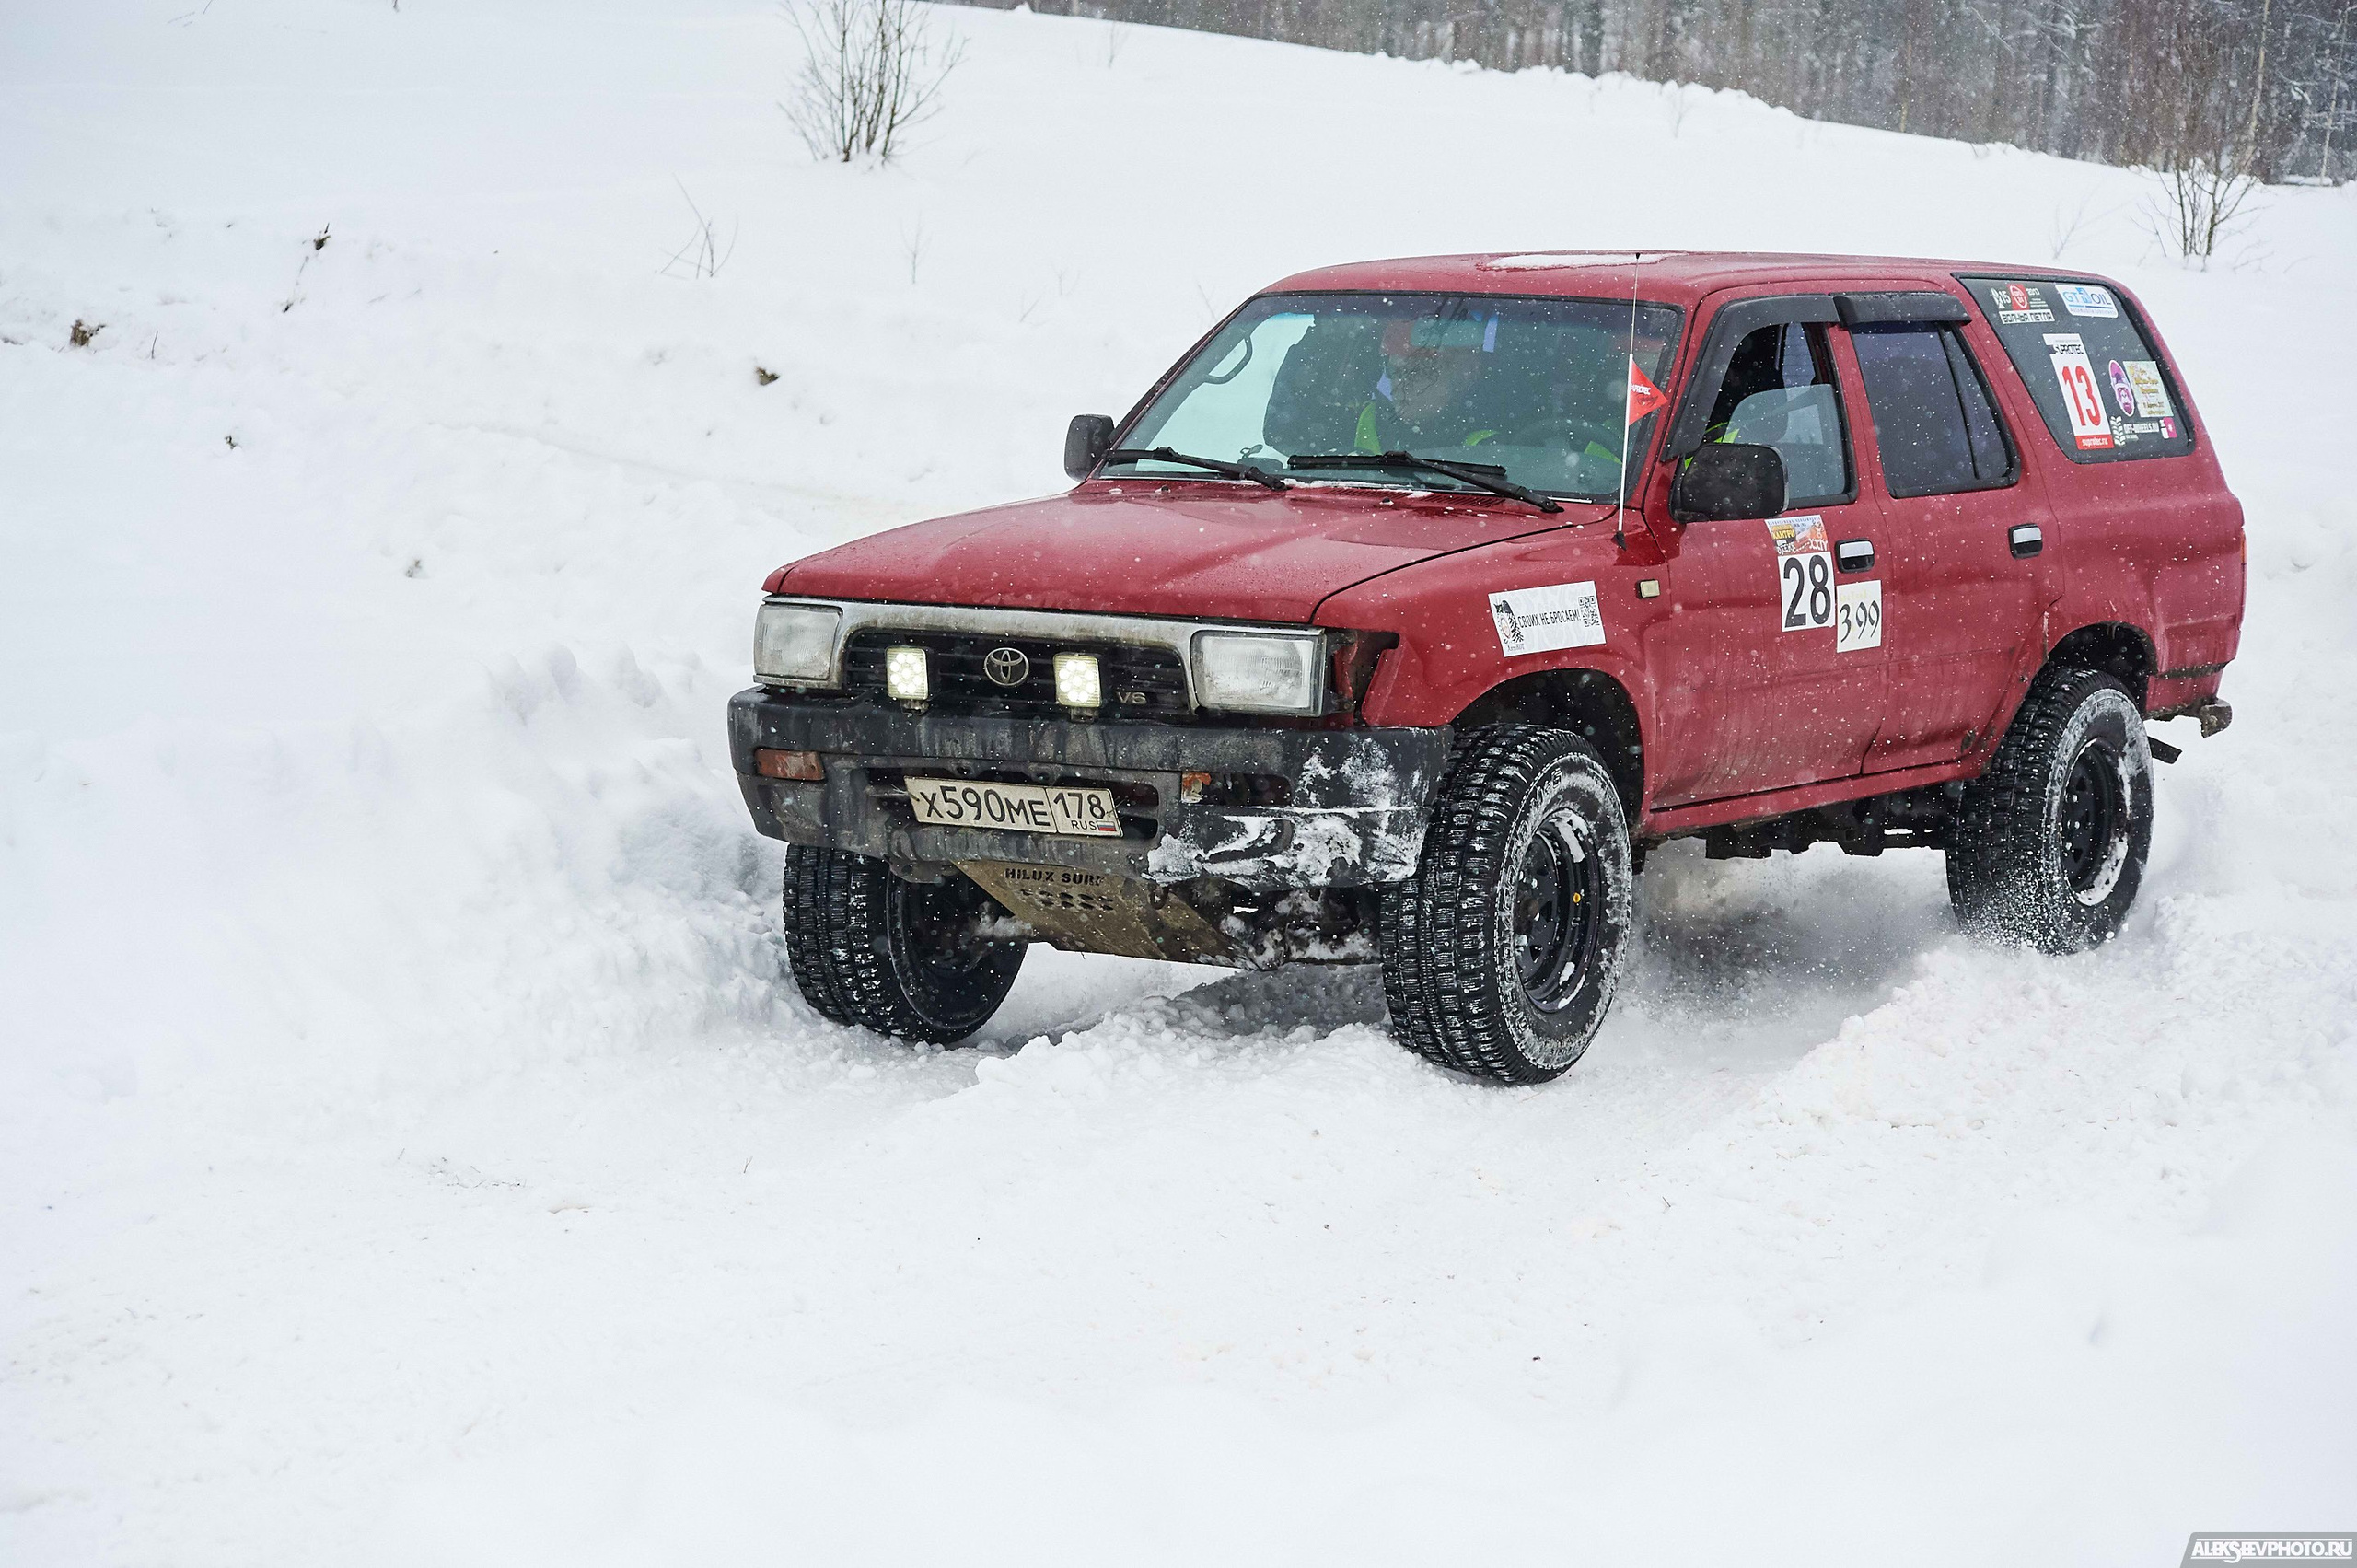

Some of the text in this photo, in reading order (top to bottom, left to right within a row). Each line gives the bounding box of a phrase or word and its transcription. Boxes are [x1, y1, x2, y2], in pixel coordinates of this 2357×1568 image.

[2091, 293, 2112, 306] OIL
[2061, 365, 2102, 426] 13
[1783, 554, 1830, 628] 28
[1517, 608, 1582, 628] СВОИХ НЕ БРОСАЕМ!
[1840, 599, 1880, 643] 399
[1117, 691, 1147, 704] V6
[1053, 792, 1106, 819] 178
[1071, 819, 1097, 830] RUS
[1005, 868, 1054, 883] HILUX
